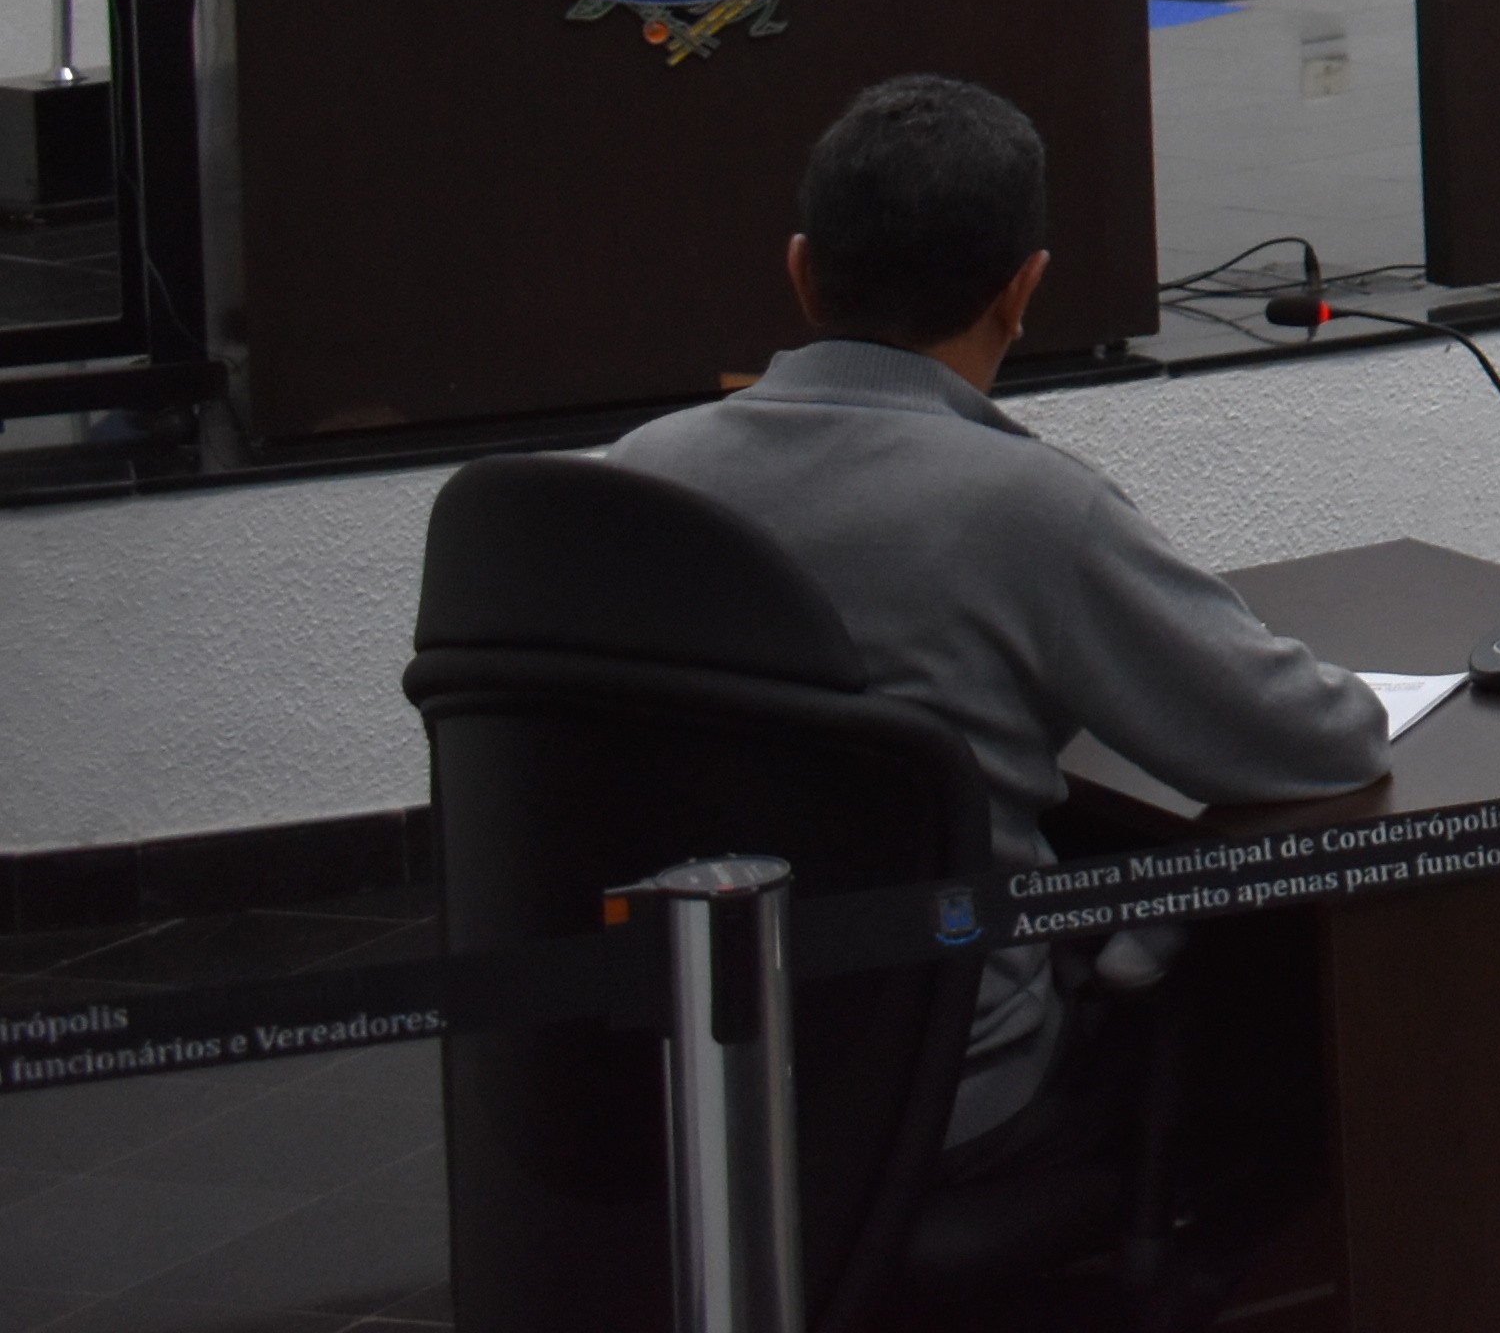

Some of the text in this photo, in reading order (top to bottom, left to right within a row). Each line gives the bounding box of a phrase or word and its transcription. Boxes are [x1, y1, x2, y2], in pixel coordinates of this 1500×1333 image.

[1009, 864, 1121, 898] Câmara
[1129, 837, 1273, 882] Municipal
[1280, 830, 1314, 859] de
[1012, 902, 1113, 938] Acesso
[1121, 880, 1231, 920] restrito
[1237, 867, 1338, 907] apenas
[1345, 855, 1410, 895] para
[11, 1032, 224, 1084] funcionários
[229, 1032, 248, 1053] e
[254, 1007, 449, 1053] Vereadores.
